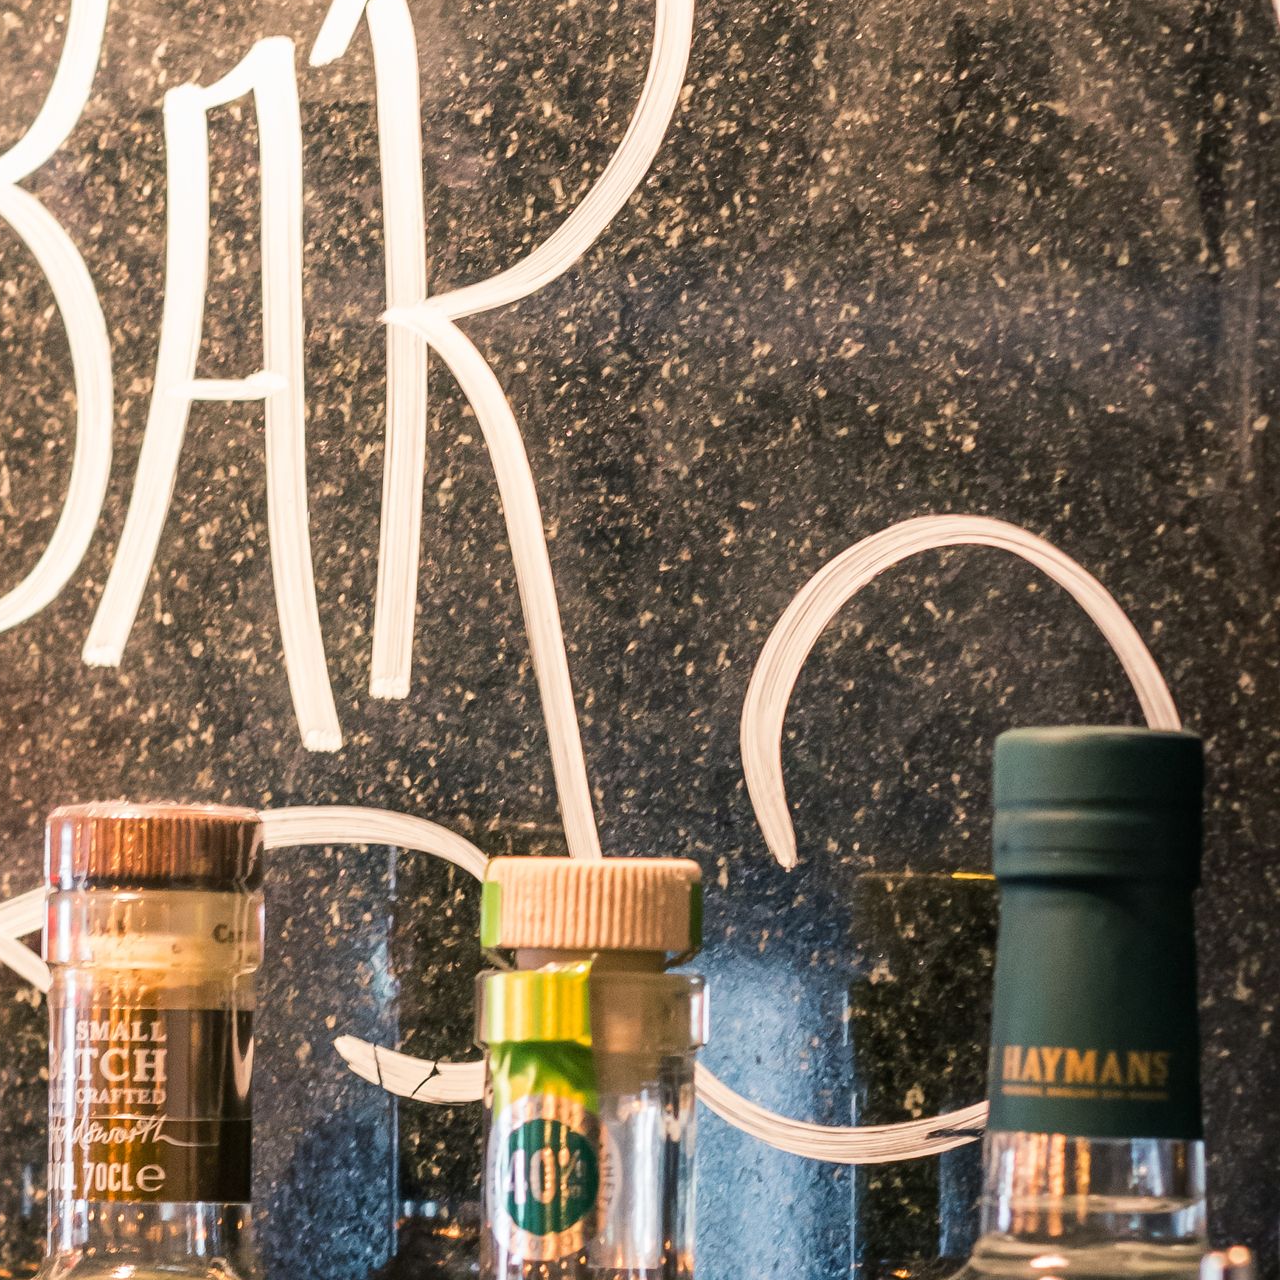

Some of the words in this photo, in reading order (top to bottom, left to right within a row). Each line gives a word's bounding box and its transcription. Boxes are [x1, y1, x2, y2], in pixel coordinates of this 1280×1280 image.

[75, 1020, 168, 1042] SMALL
[1002, 1045, 1169, 1087] HAYMANS
[75, 1087, 167, 1105] CRAFTED
